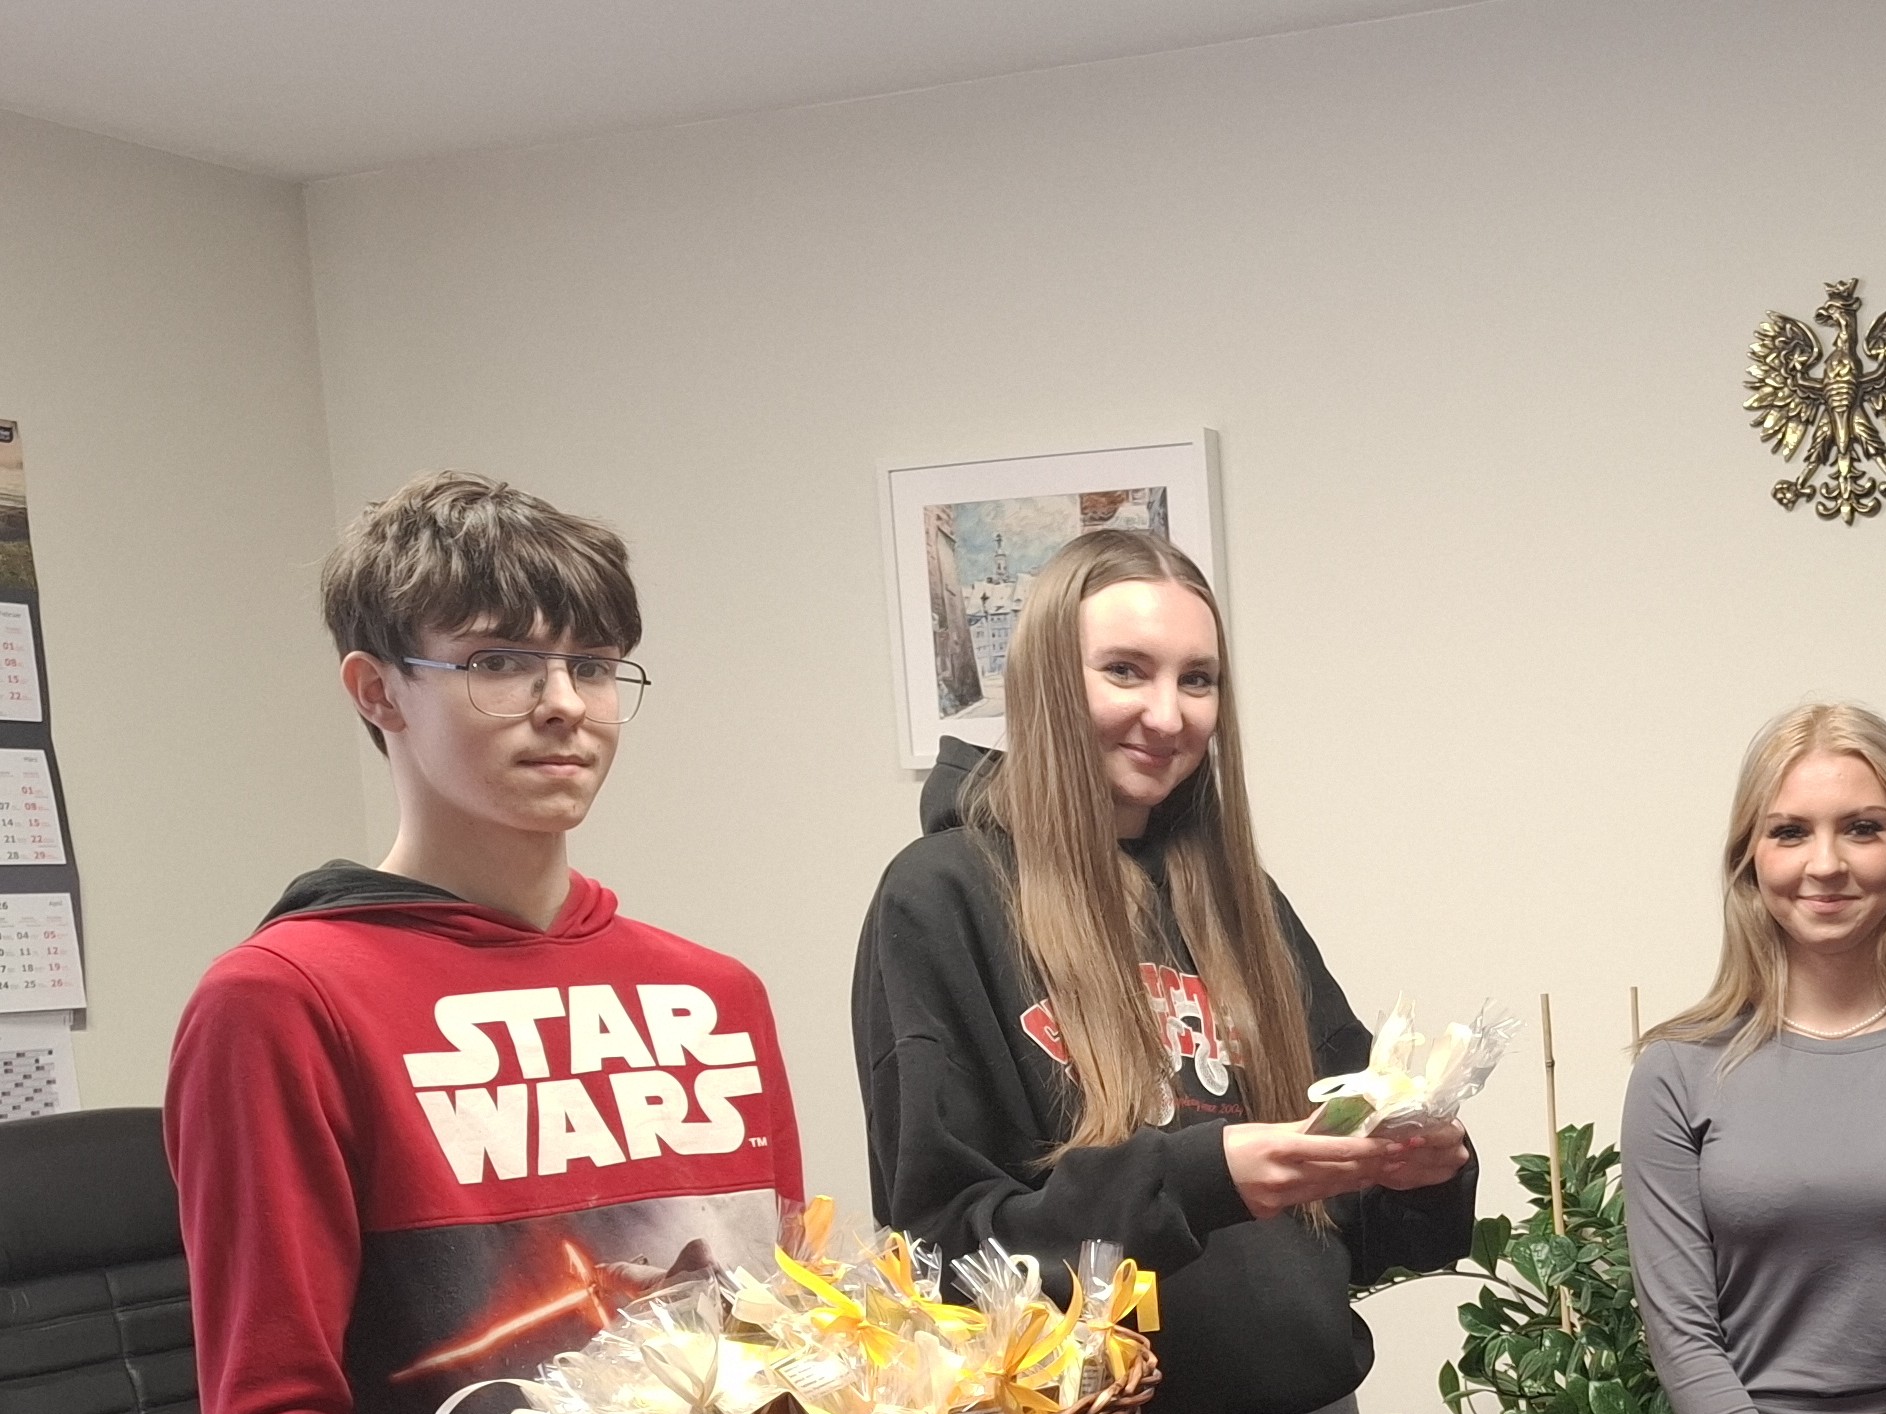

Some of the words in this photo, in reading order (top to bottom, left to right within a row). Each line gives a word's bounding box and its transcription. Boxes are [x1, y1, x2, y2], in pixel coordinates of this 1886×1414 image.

[2, 818, 13, 827] 14
[4, 834, 15, 844] 21
[16, 931, 29, 940] 04
[20, 947, 31, 957] 11
[47, 946, 58, 955] 12
[403, 984, 756, 1088] STAR
[415, 1065, 763, 1185] WARS
